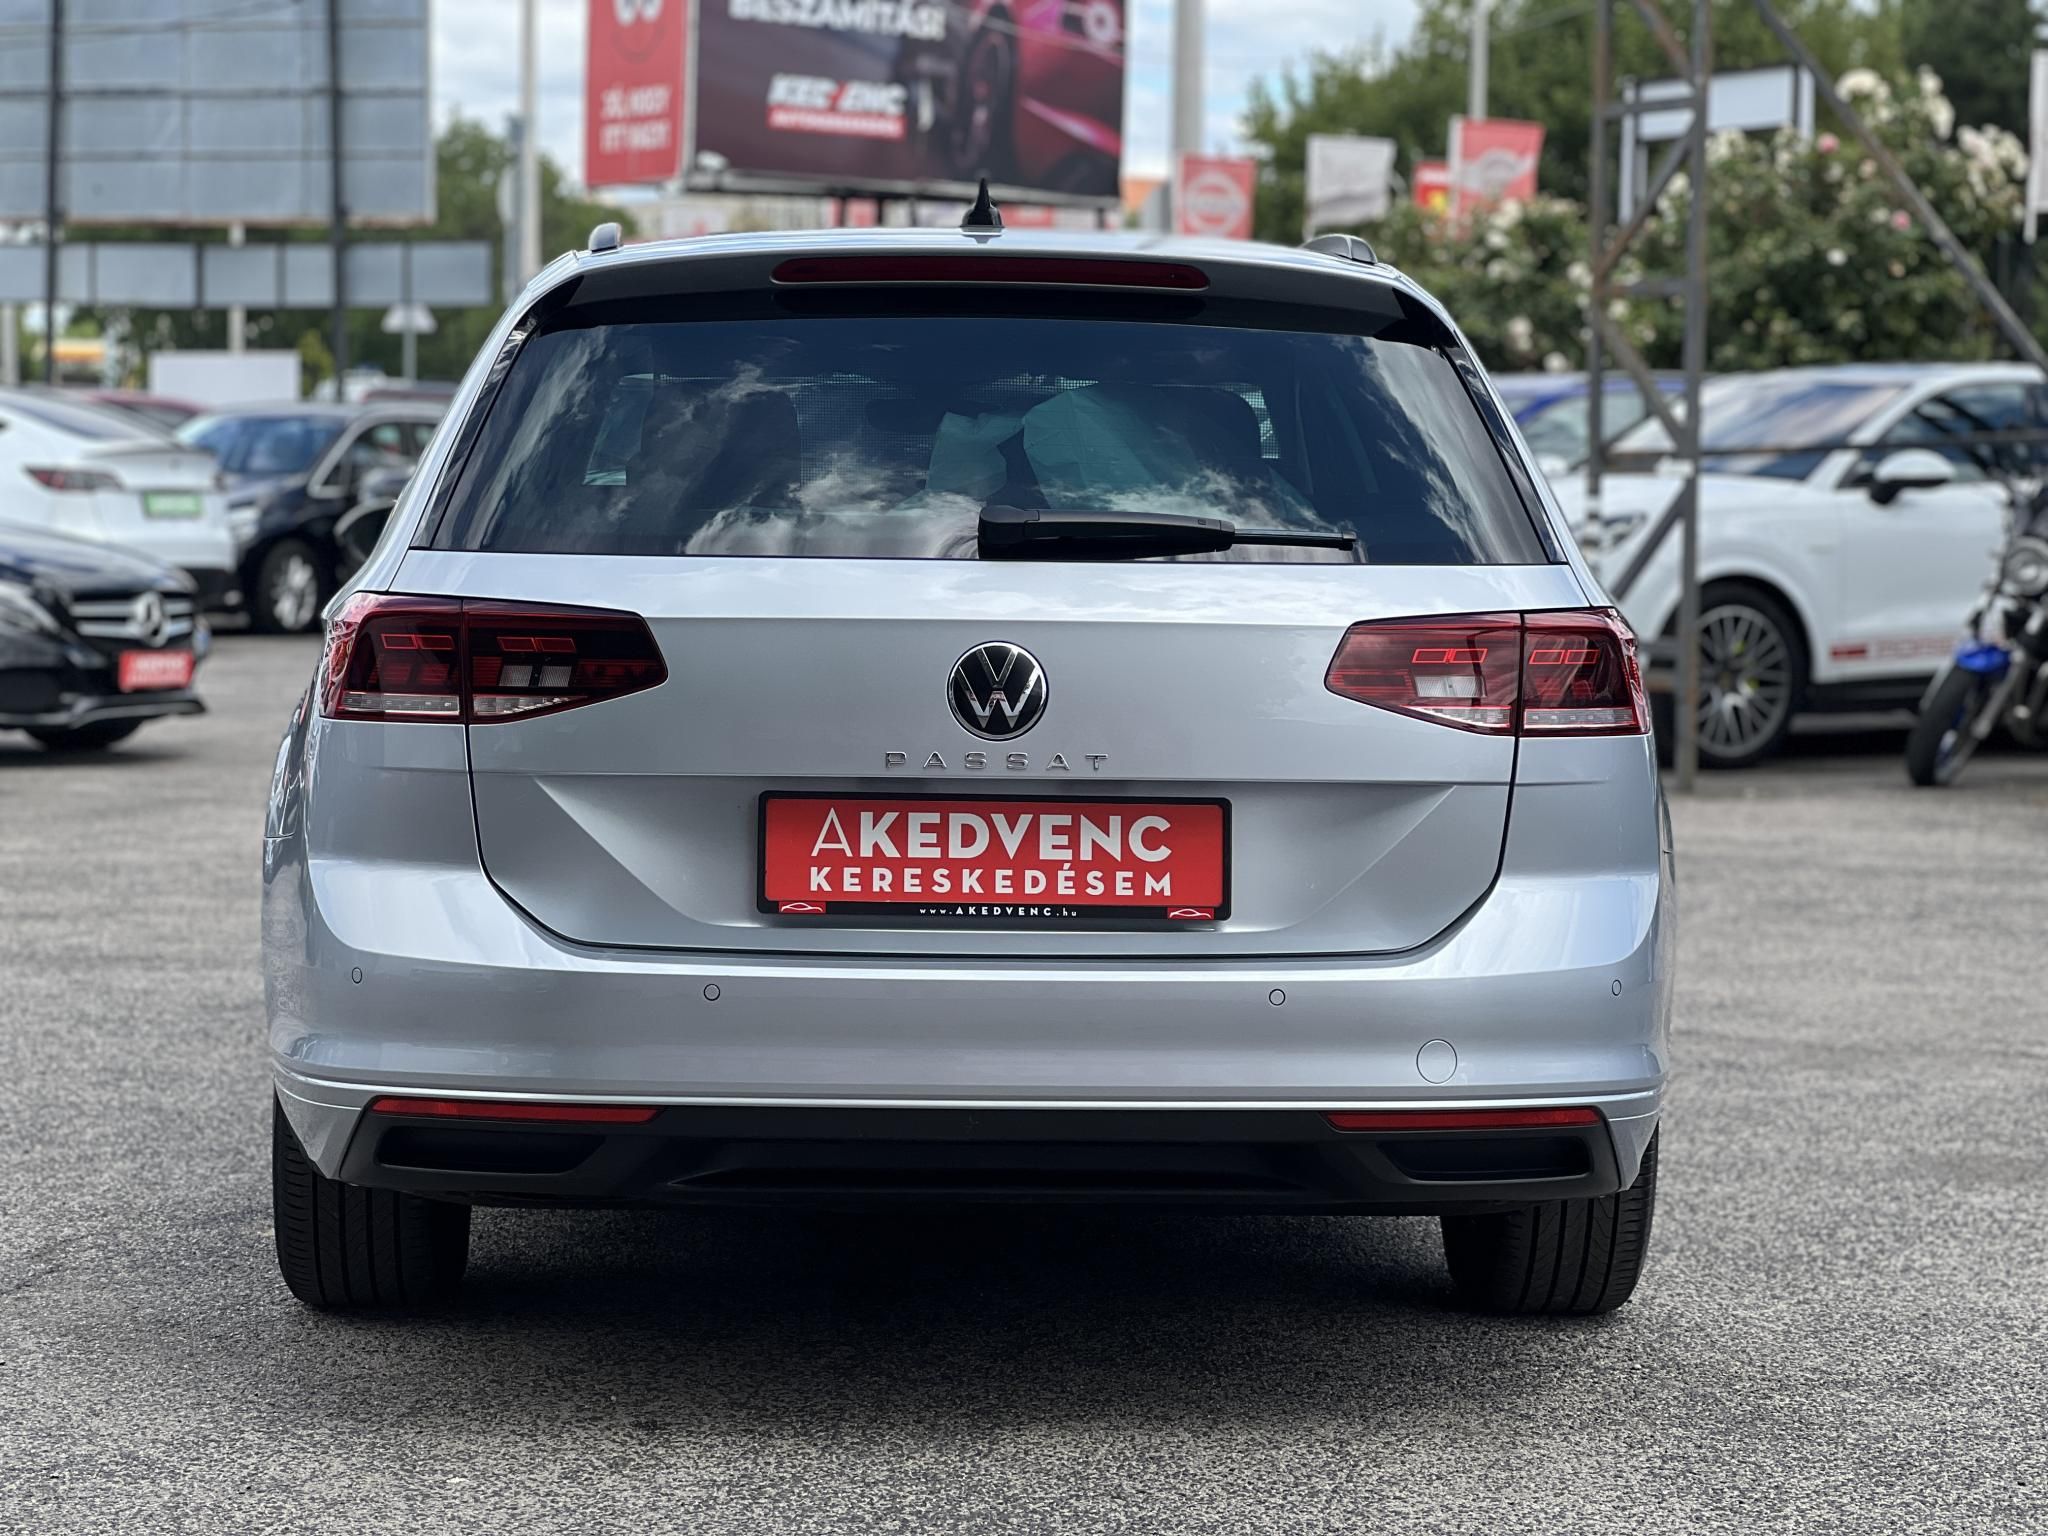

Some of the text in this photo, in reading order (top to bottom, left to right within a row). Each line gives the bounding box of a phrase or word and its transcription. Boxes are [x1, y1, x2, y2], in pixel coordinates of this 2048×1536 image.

[885, 751, 1109, 771] PASSAT
[809, 862, 1172, 897] KERESKEDÉSEM
[919, 906, 1077, 917] www.AKEDVENC.hu
